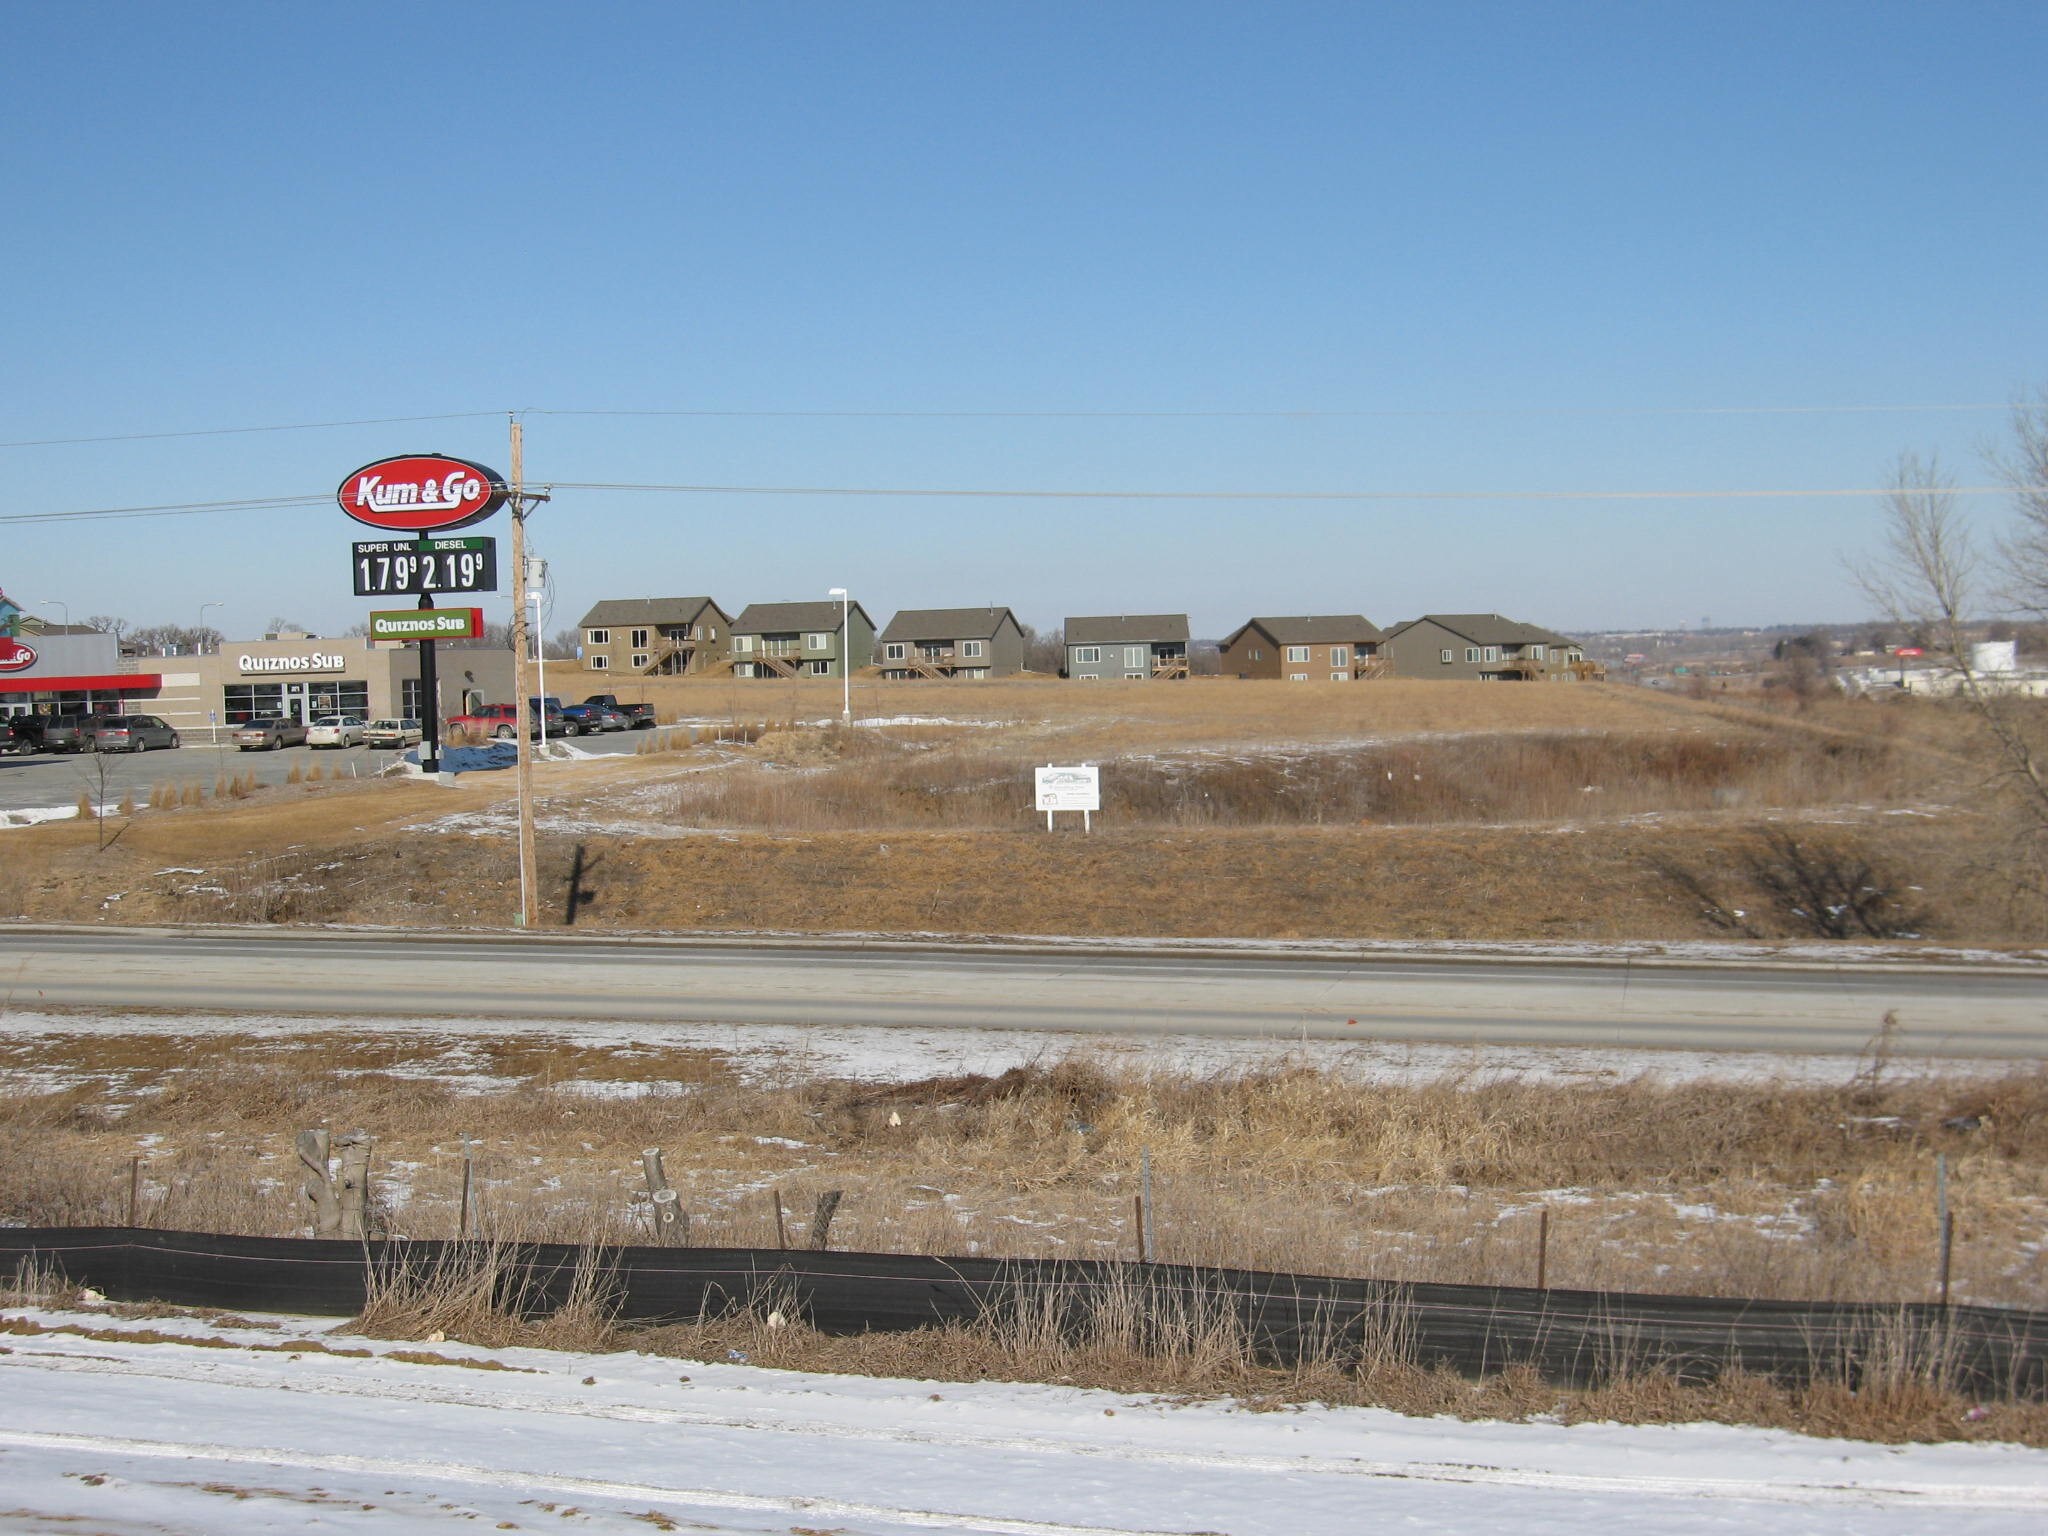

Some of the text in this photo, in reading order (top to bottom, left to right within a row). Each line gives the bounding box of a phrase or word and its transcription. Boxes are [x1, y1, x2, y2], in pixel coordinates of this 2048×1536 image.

[356, 471, 481, 508] Kum & Go
[358, 542, 412, 553] SUPER UNL
[434, 541, 466, 550] DIESEL
